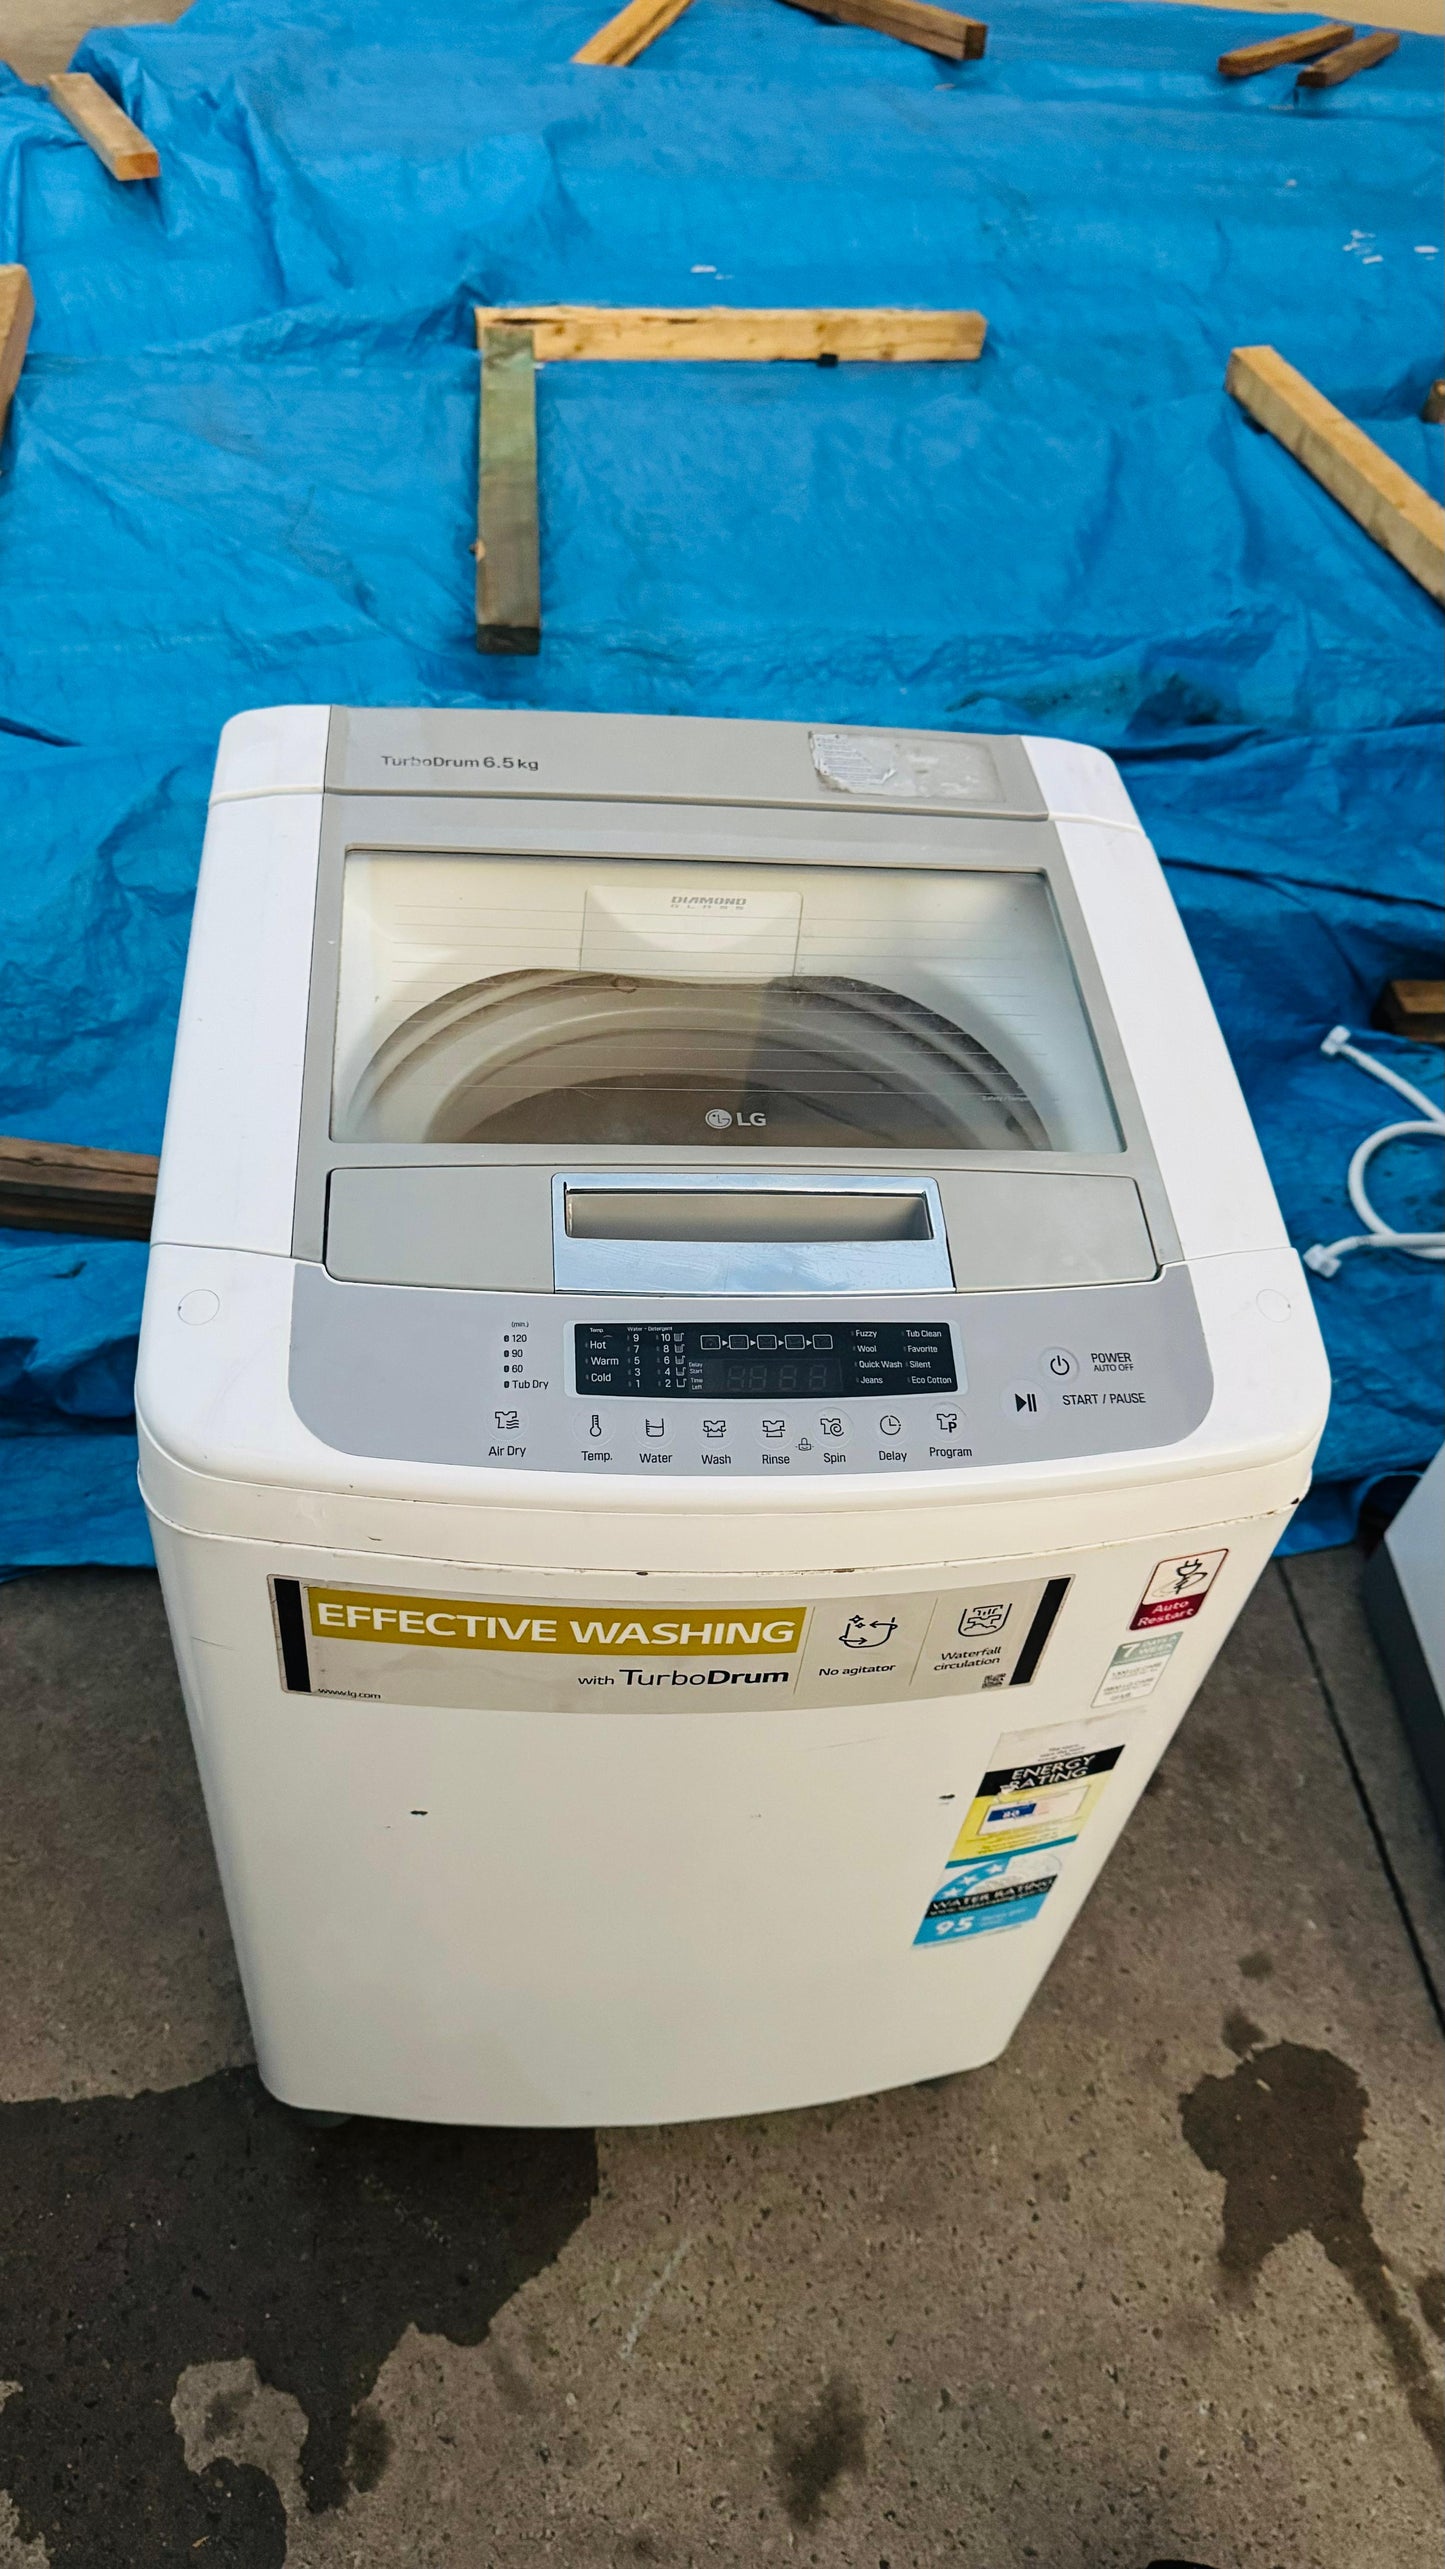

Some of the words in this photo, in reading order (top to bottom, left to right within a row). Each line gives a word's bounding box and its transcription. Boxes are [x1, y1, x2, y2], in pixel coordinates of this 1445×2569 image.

[381, 755, 479, 768] TurboDrum
[671, 896, 747, 905] DIAMOND
[736, 1112, 767, 1126] LG
[512, 1334, 527, 1342] 120
[633, 1333, 639, 1342] 9
[661, 1333, 671, 1341] 10
[855, 1330, 877, 1338] Fuzzy
[590, 1341, 607, 1349] Hot
[633, 1345, 639, 1353] 7
[663, 1344, 670, 1353] 8
[590, 1356, 619, 1365] Warm
[634, 1356, 640, 1364] 5
[663, 1356, 670, 1364] 6
[1091, 1352, 1132, 1363] POWER
[512, 1365, 523, 1373] 60
[859, 1360, 880, 1368] Quick
[909, 1360, 931, 1368] Silent
[1093, 1364, 1117, 1372] AUTO
[1118, 1363, 1134, 1371] OFF
[634, 1367, 641, 1376] 3
[664, 1367, 671, 1376] 4
[591, 1373, 612, 1382] Cold
[860, 1376, 884, 1384] Jeans
[911, 1376, 925, 1384] Eco
[927, 1376, 952, 1384] Cotton
[512, 1380, 530, 1388] Tub
[532, 1380, 549, 1390] Dry
[665, 1379, 671, 1387] 2
[1062, 1394, 1098, 1405] START
[1109, 1392, 1146, 1404] PAUSE
[488, 1446, 505, 1456] Air
[507, 1445, 527, 1457] Dry
[878, 1450, 907, 1462] Delay
[929, 1447, 972, 1458] Program
[581, 1451, 613, 1462] Temp.
[639, 1453, 673, 1463] Water
[701, 1454, 732, 1464] Wash
[762, 1454, 790, 1464] Rinse
[823, 1452, 846, 1464] Spin
[1152, 1600, 1190, 1614] Auto
[1137, 1608, 1195, 1626] Restart
[317, 1602, 557, 1642] EFFECTIVE
[569, 1620, 796, 1645] WASHING
[941, 1646, 1002, 1661] Waterfall
[1122, 1642, 1140, 1658] 7
[933, 1657, 1000, 1671] circulation
[818, 1667, 839, 1676] No
[842, 1663, 896, 1677] agitator
[578, 1675, 615, 1686] with
[619, 1669, 789, 1686] TurboDrum
[317, 1687, 381, 1700] www.lg.com
[1011, 1755, 1096, 1780] ENERGY
[1009, 1766, 1088, 1790] RATING
[932, 1893, 990, 1910] WATER
[994, 1878, 1053, 1898] RATING
[935, 1916, 975, 1935] 95
